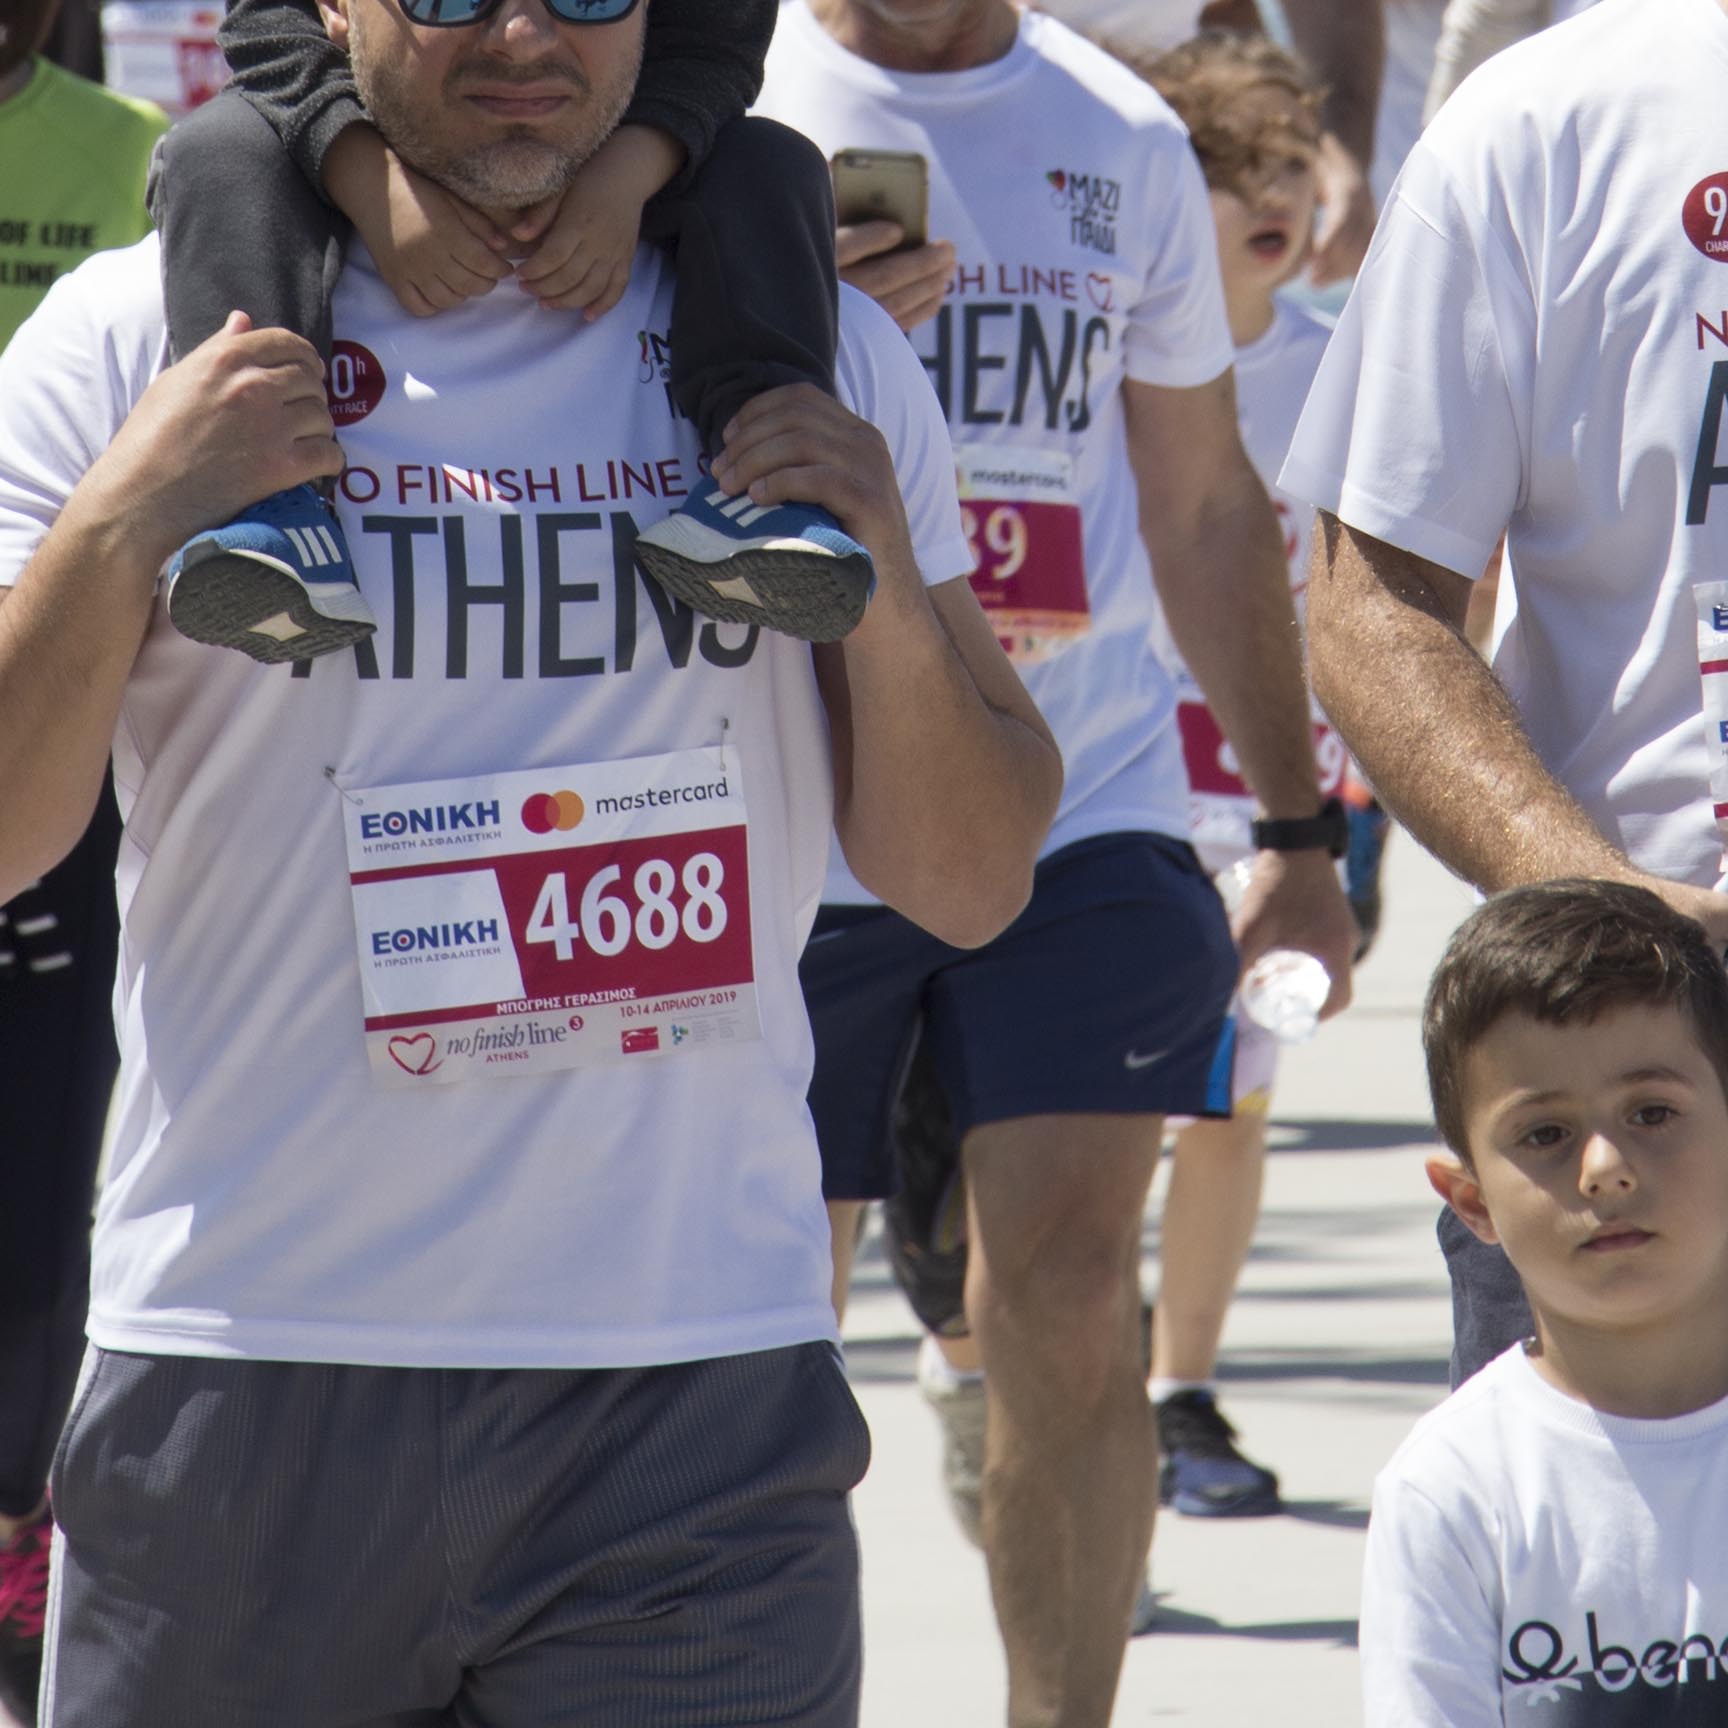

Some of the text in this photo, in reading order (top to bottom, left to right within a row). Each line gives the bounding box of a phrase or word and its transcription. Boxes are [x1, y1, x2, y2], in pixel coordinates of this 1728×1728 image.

[40, 222, 98, 249] LIFE
[998, 264, 1078, 300] LINE
[344, 400, 368, 414] RACE
[396, 464, 562, 505] FINISH
[576, 459, 689, 502] LINE
[595, 777, 729, 815] mastercard
[525, 852, 728, 961] 4688
[620, 1005, 650, 1018] 10-14
[710, 990, 737, 1005] 2019
[447, 1037, 471, 1055] no
[469, 1023, 526, 1059] finish
[527, 1022, 567, 1046] line
[486, 1050, 530, 1064] ATHENS
